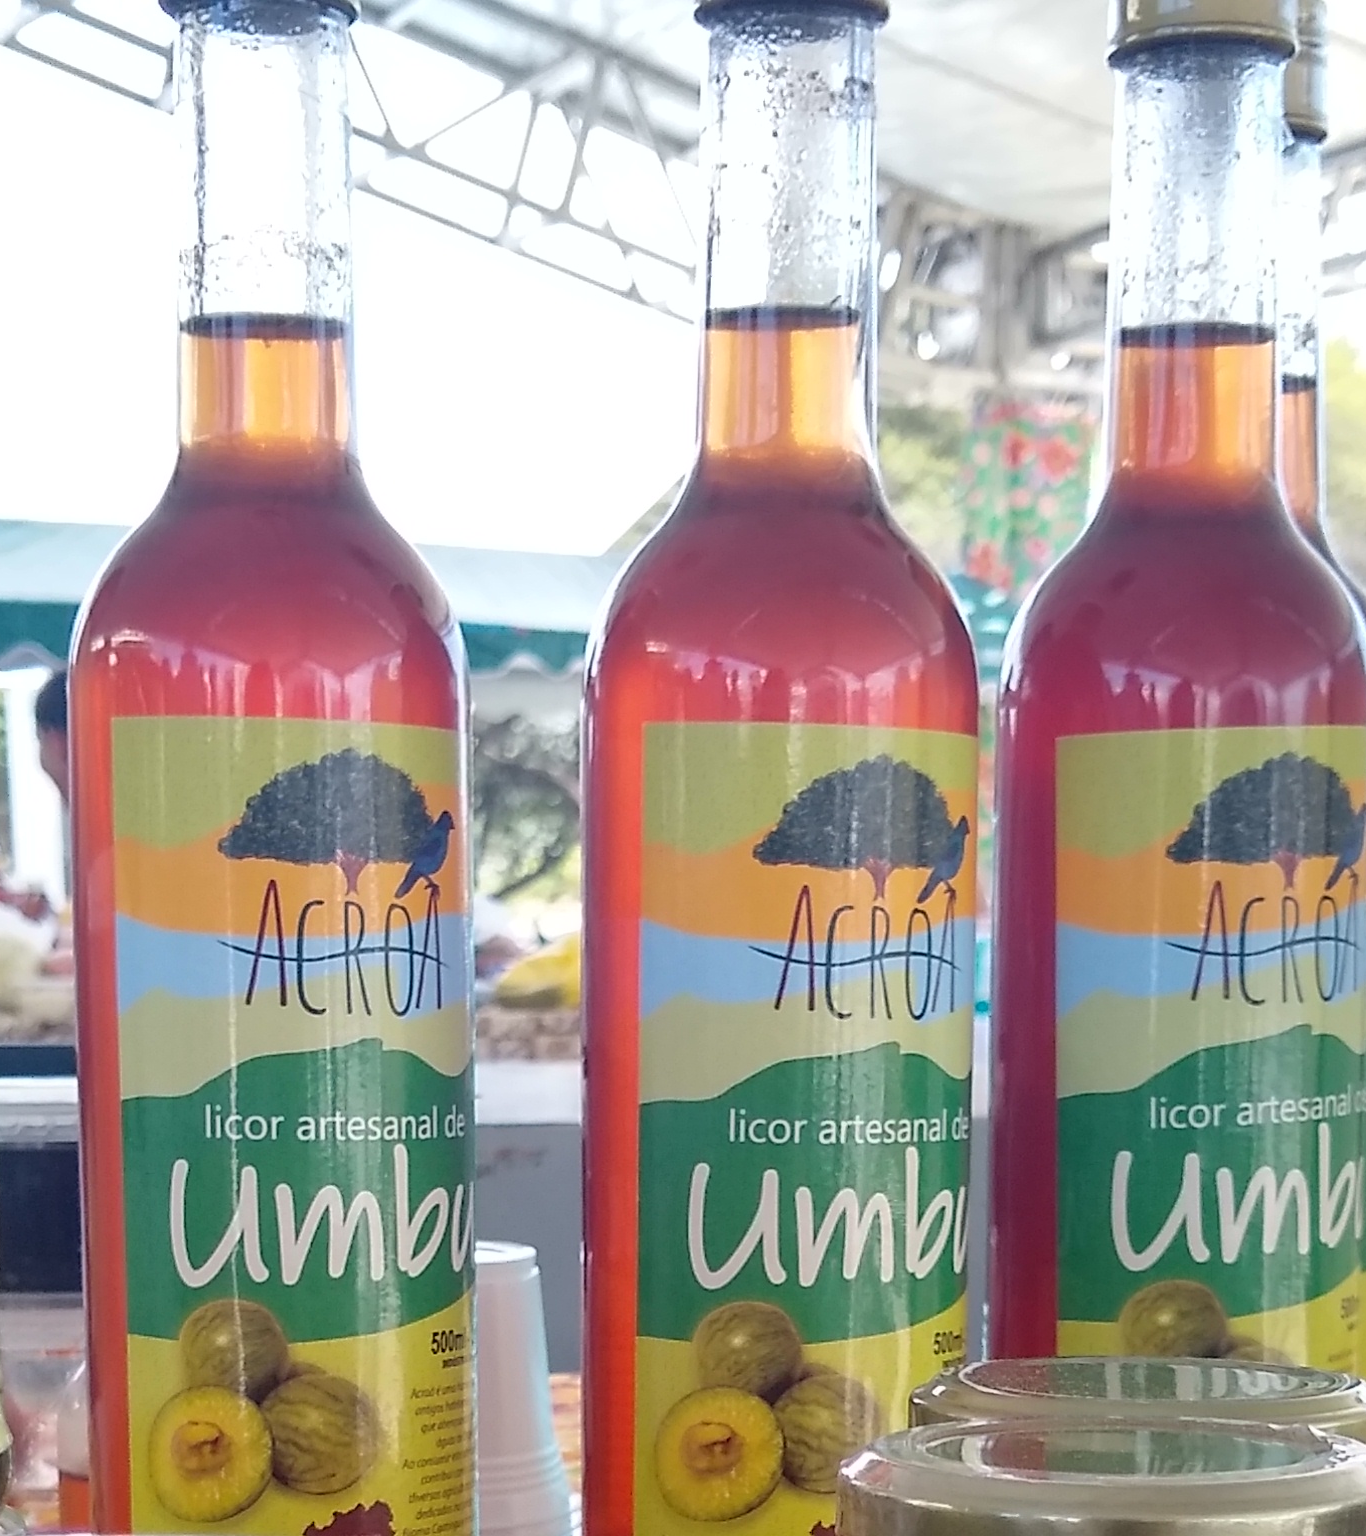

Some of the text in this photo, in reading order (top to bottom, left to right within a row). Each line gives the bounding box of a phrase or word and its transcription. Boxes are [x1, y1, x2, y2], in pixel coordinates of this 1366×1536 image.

[205, 1103, 466, 1141] licor artesanal de
[729, 1107, 807, 1145] licor
[818, 1107, 947, 1145] artesanal
[1150, 1095, 1228, 1131] licor
[1236, 1083, 1353, 1128] artesanal
